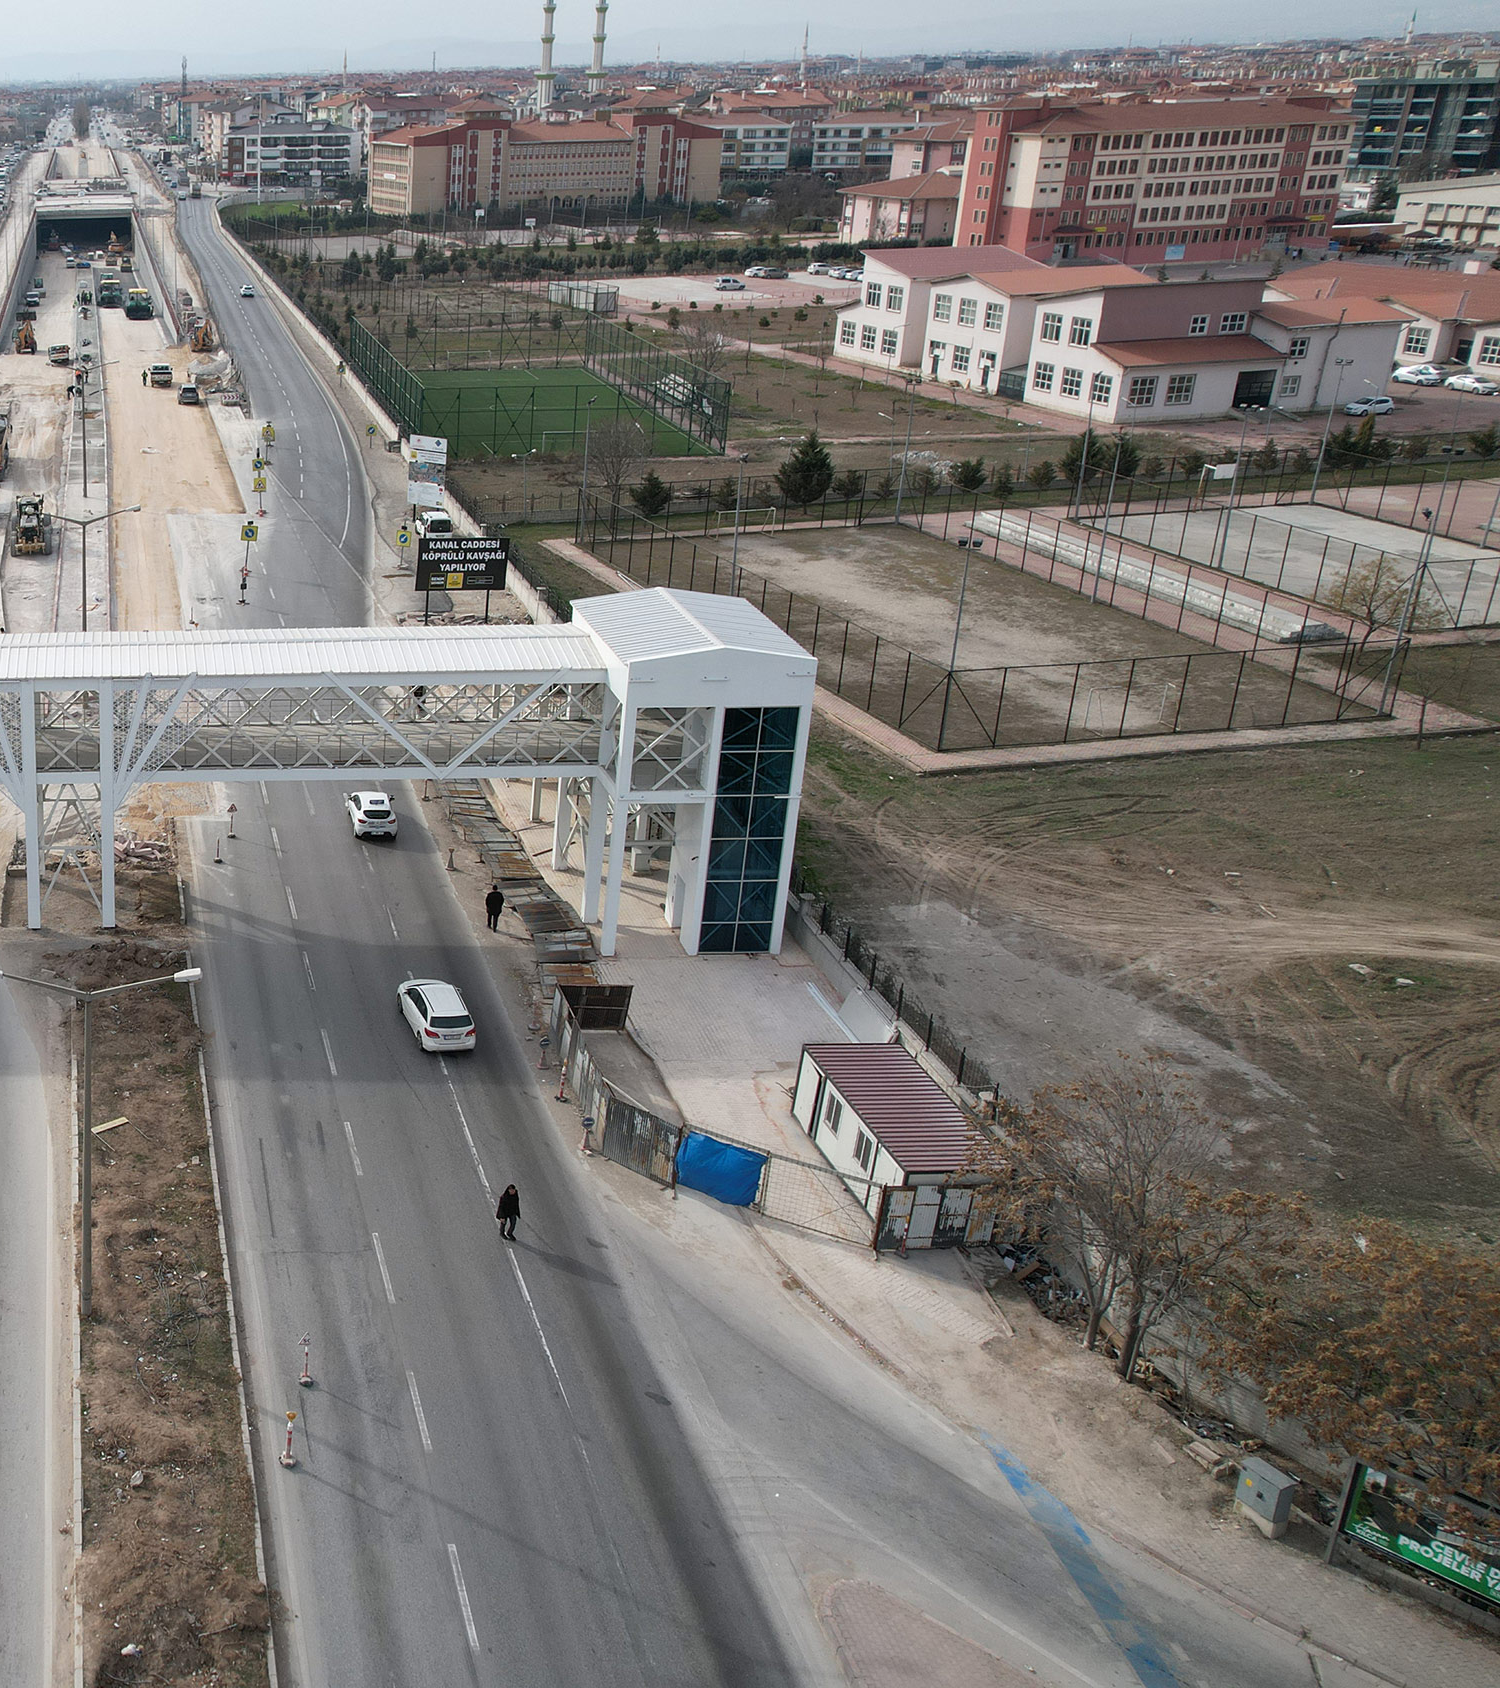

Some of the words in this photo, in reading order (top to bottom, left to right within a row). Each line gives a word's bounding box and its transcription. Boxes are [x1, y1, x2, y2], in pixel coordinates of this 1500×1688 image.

[429, 541, 459, 549] KANAL
[461, 539, 500, 549] CADDESİ
[422, 550, 465, 561] KÖPRÜLÜ
[466, 549, 506, 562] KAVŞAĞI
[440, 563, 487, 572] YAPILIYOR
[1398, 1534, 1483, 1583] PROJELER
